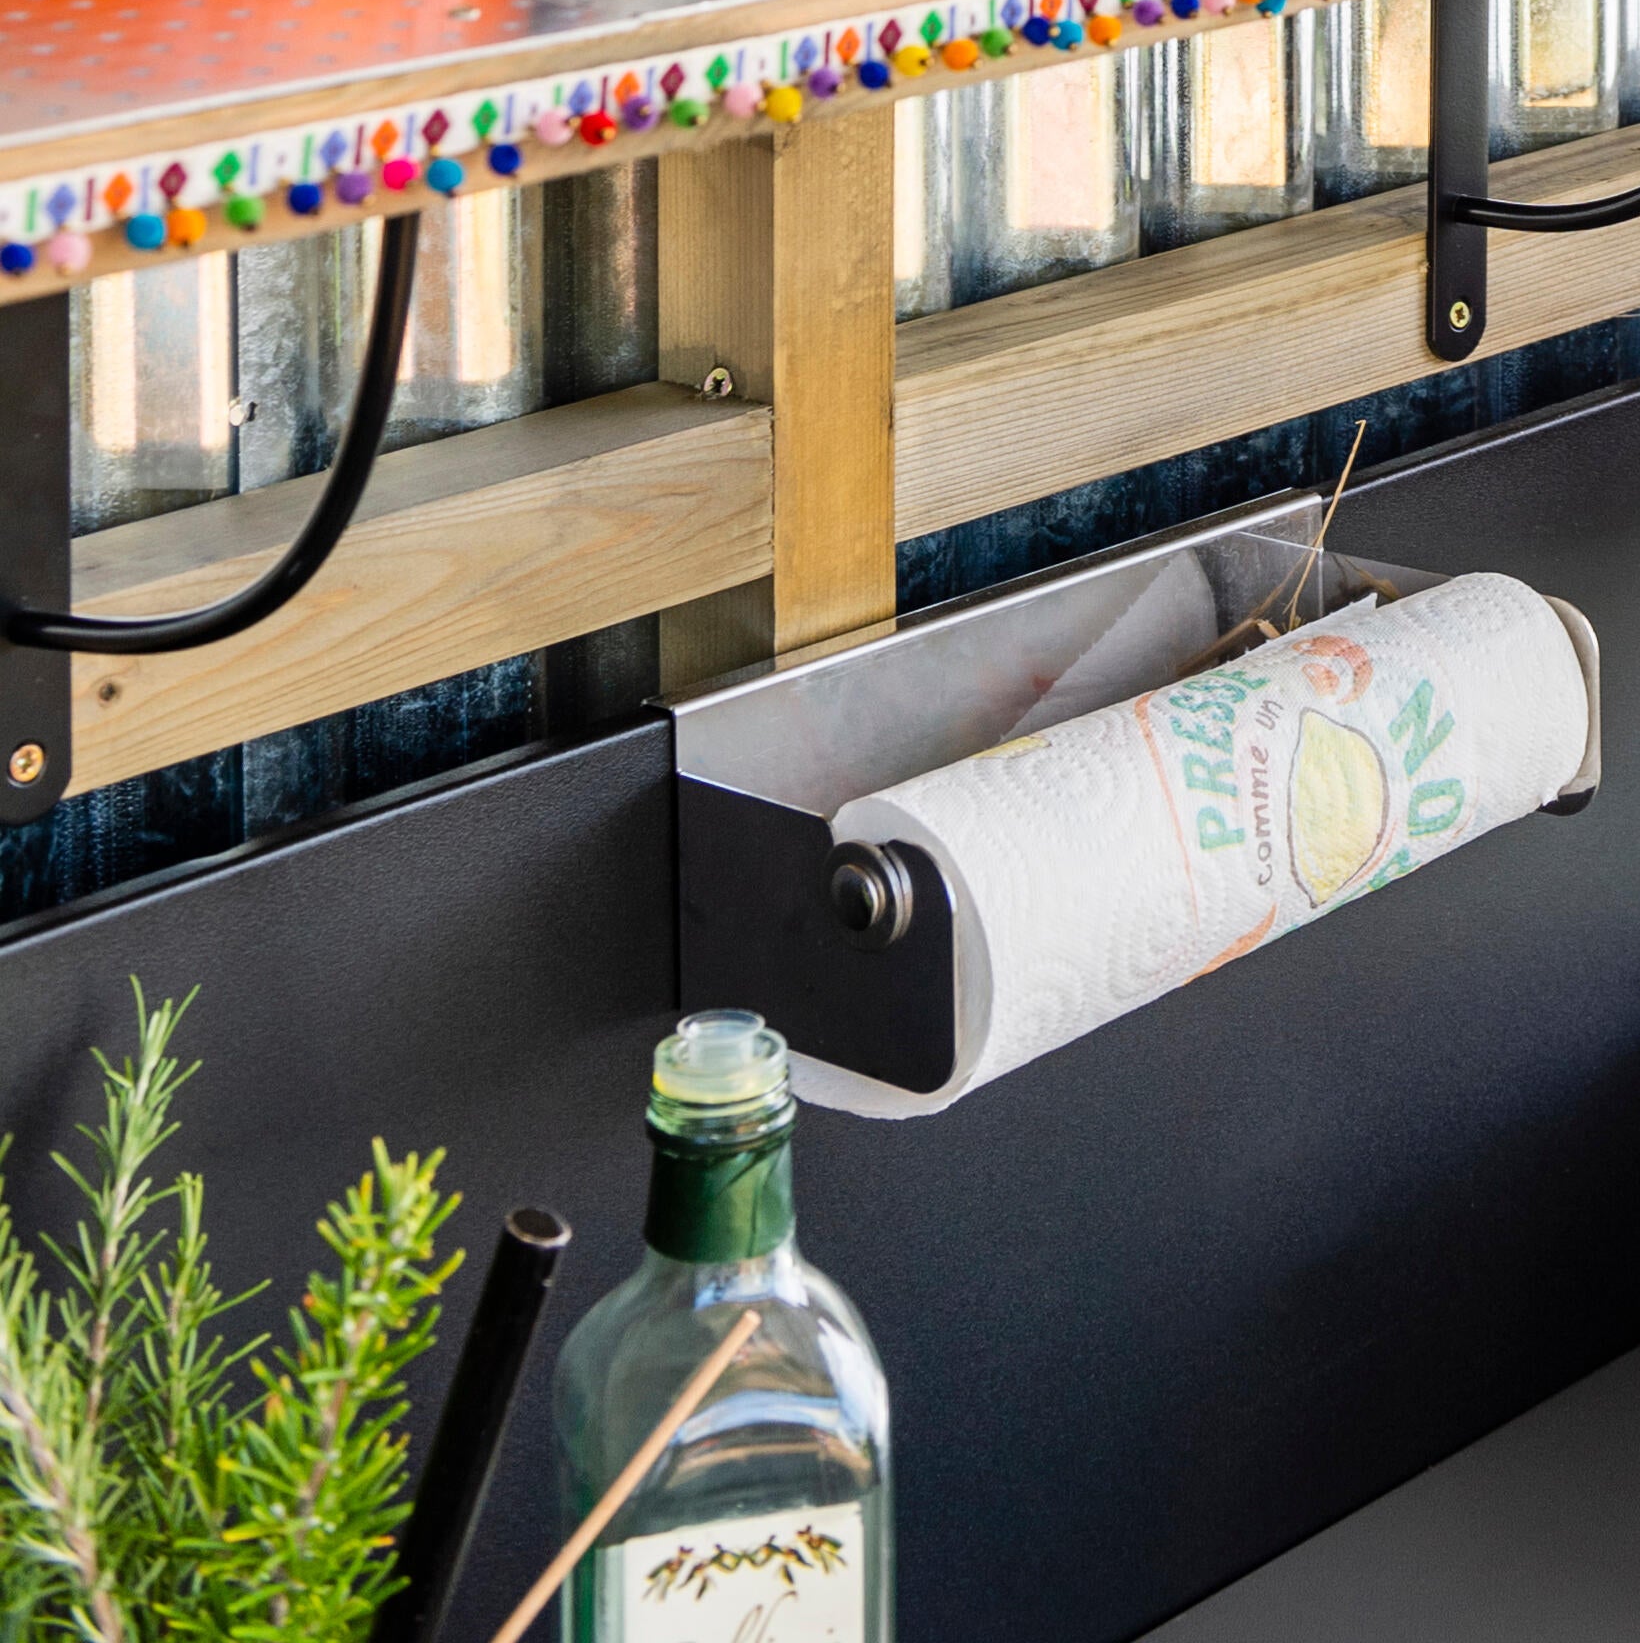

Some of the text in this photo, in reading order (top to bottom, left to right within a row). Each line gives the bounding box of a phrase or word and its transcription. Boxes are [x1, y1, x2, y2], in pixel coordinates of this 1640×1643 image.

[1168, 668, 1271, 854] PRESSE
[1249, 698, 1285, 886] comme un
